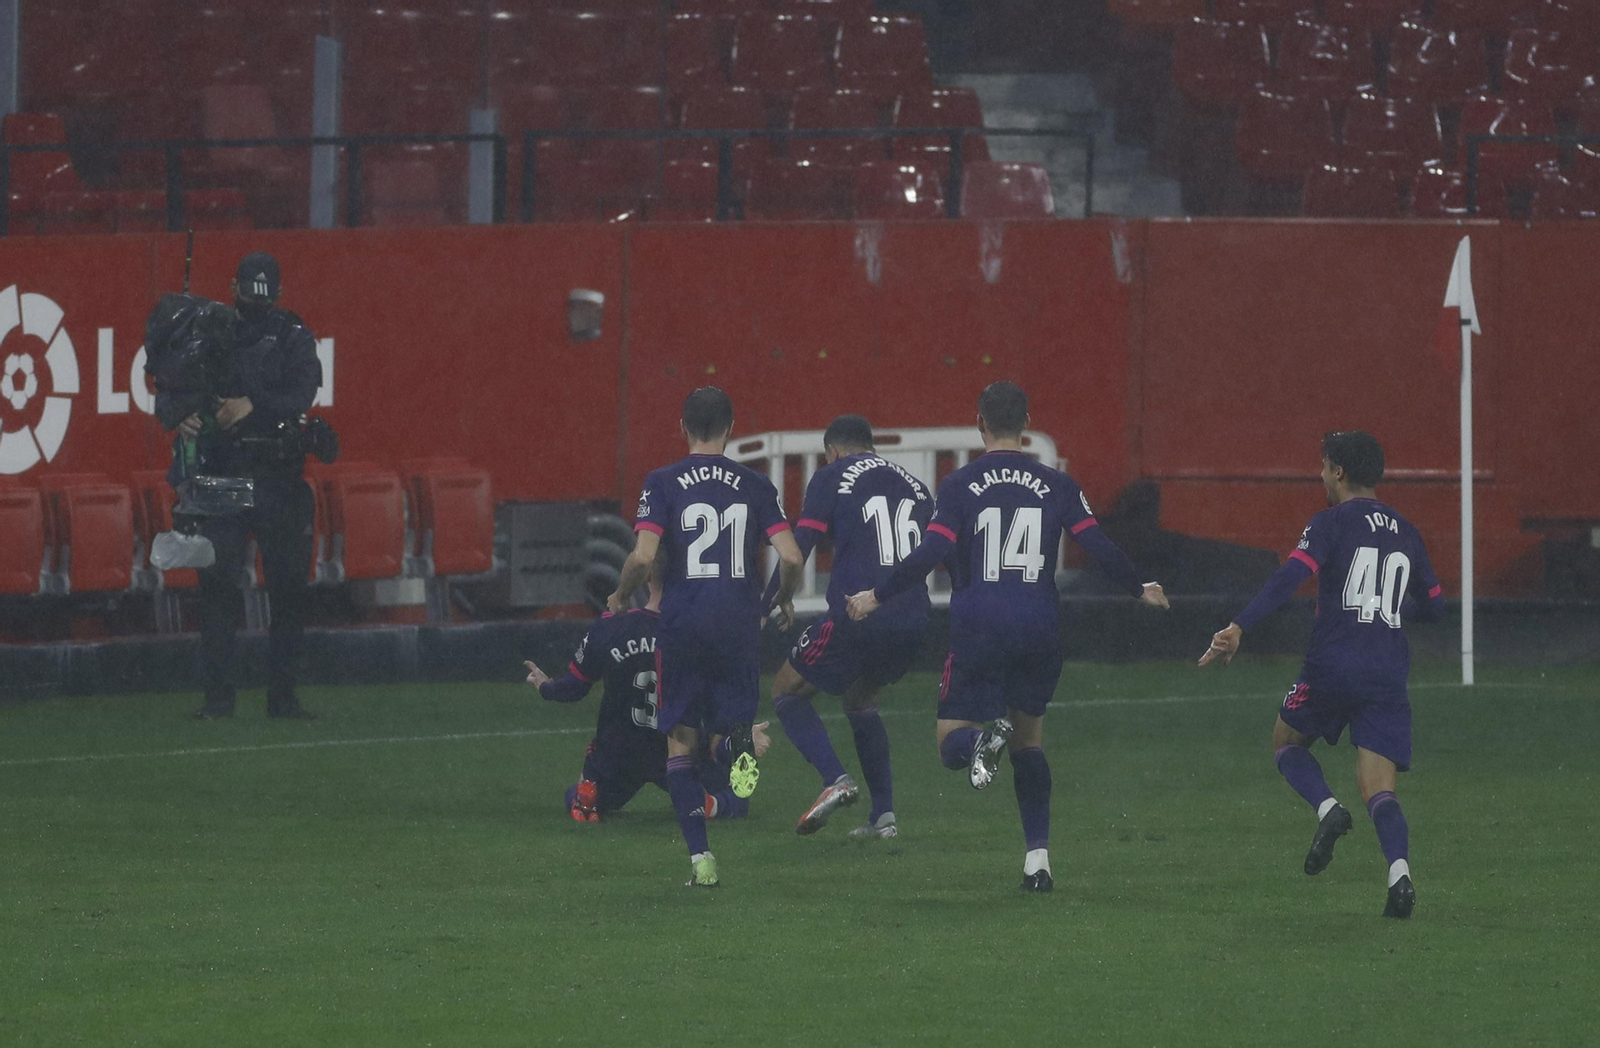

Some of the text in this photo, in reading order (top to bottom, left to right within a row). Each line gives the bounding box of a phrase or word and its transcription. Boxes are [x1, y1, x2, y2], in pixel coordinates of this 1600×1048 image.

[837, 457, 887, 494] MARCOS
[967, 468, 1052, 499] R.ALCARAZ
[680, 502, 748, 579] 21
[861, 495, 922, 566] 16
[974, 506, 1045, 583] 14
[1363, 511, 1399, 535] JOTA
[1341, 546, 1410, 629] 40
[631, 670, 658, 730] 3
